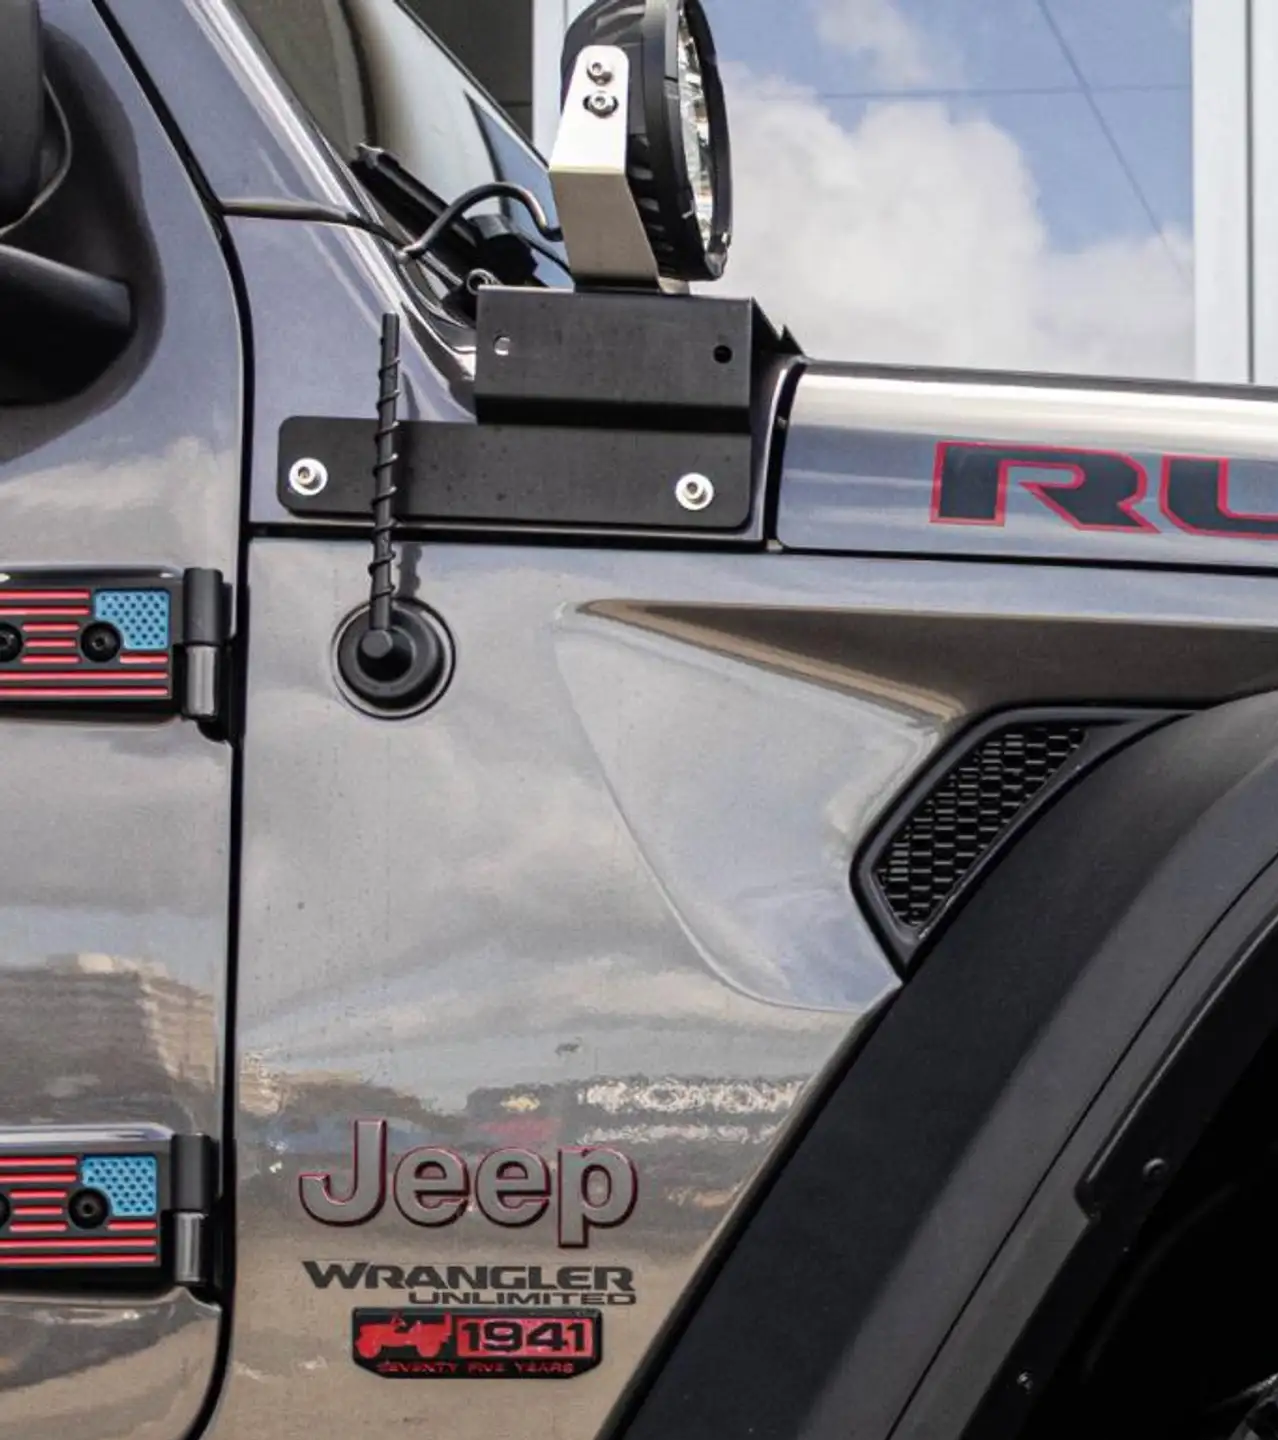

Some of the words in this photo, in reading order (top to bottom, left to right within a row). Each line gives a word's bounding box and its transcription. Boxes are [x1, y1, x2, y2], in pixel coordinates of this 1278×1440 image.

[299, 1118, 638, 1249] Jeep
[302, 1260, 637, 1292] WRANGLER
[408, 1291, 637, 1306] UNLIMITED
[461, 1321, 586, 1353] 1941
